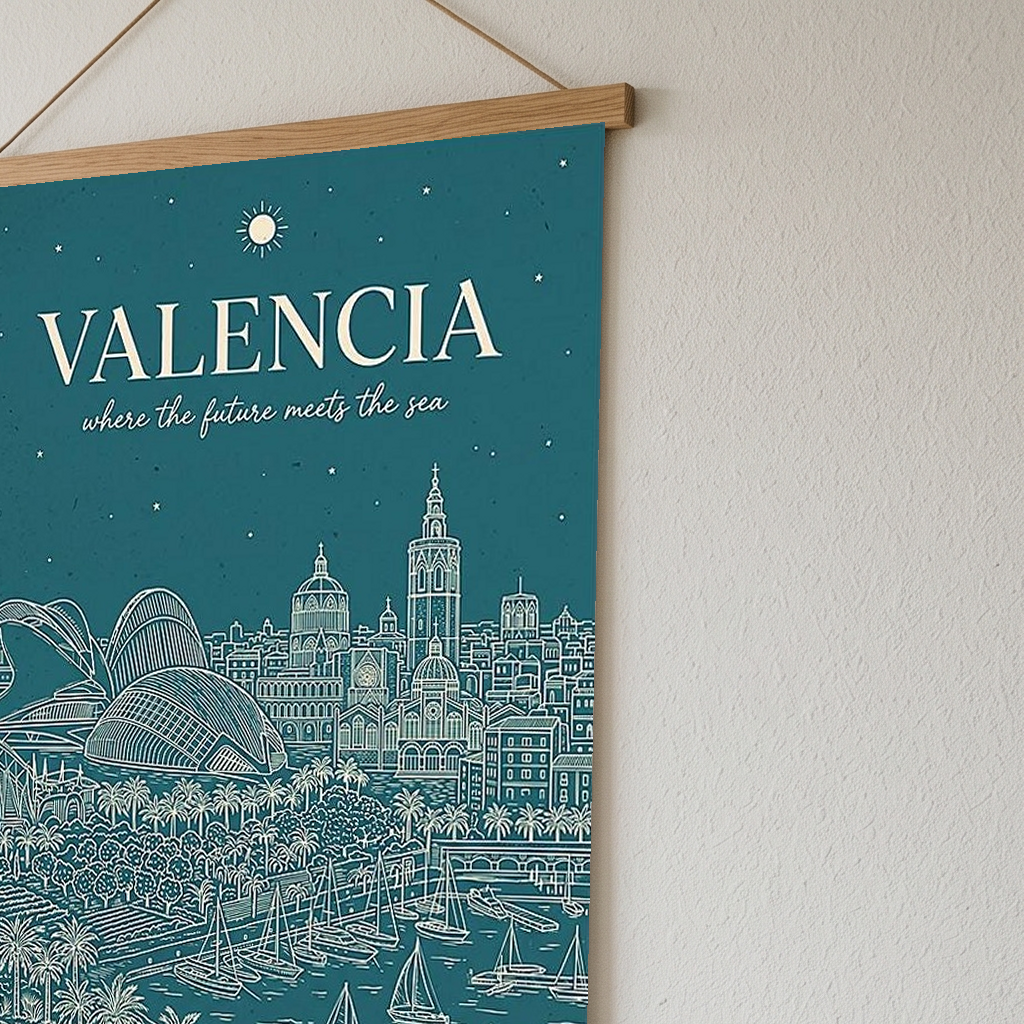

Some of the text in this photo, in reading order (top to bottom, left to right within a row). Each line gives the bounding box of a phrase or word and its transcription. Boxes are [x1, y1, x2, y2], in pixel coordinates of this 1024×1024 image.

[37, 278, 503, 385] VALENCIA
[82, 382, 449, 439] where the future meets the sea
